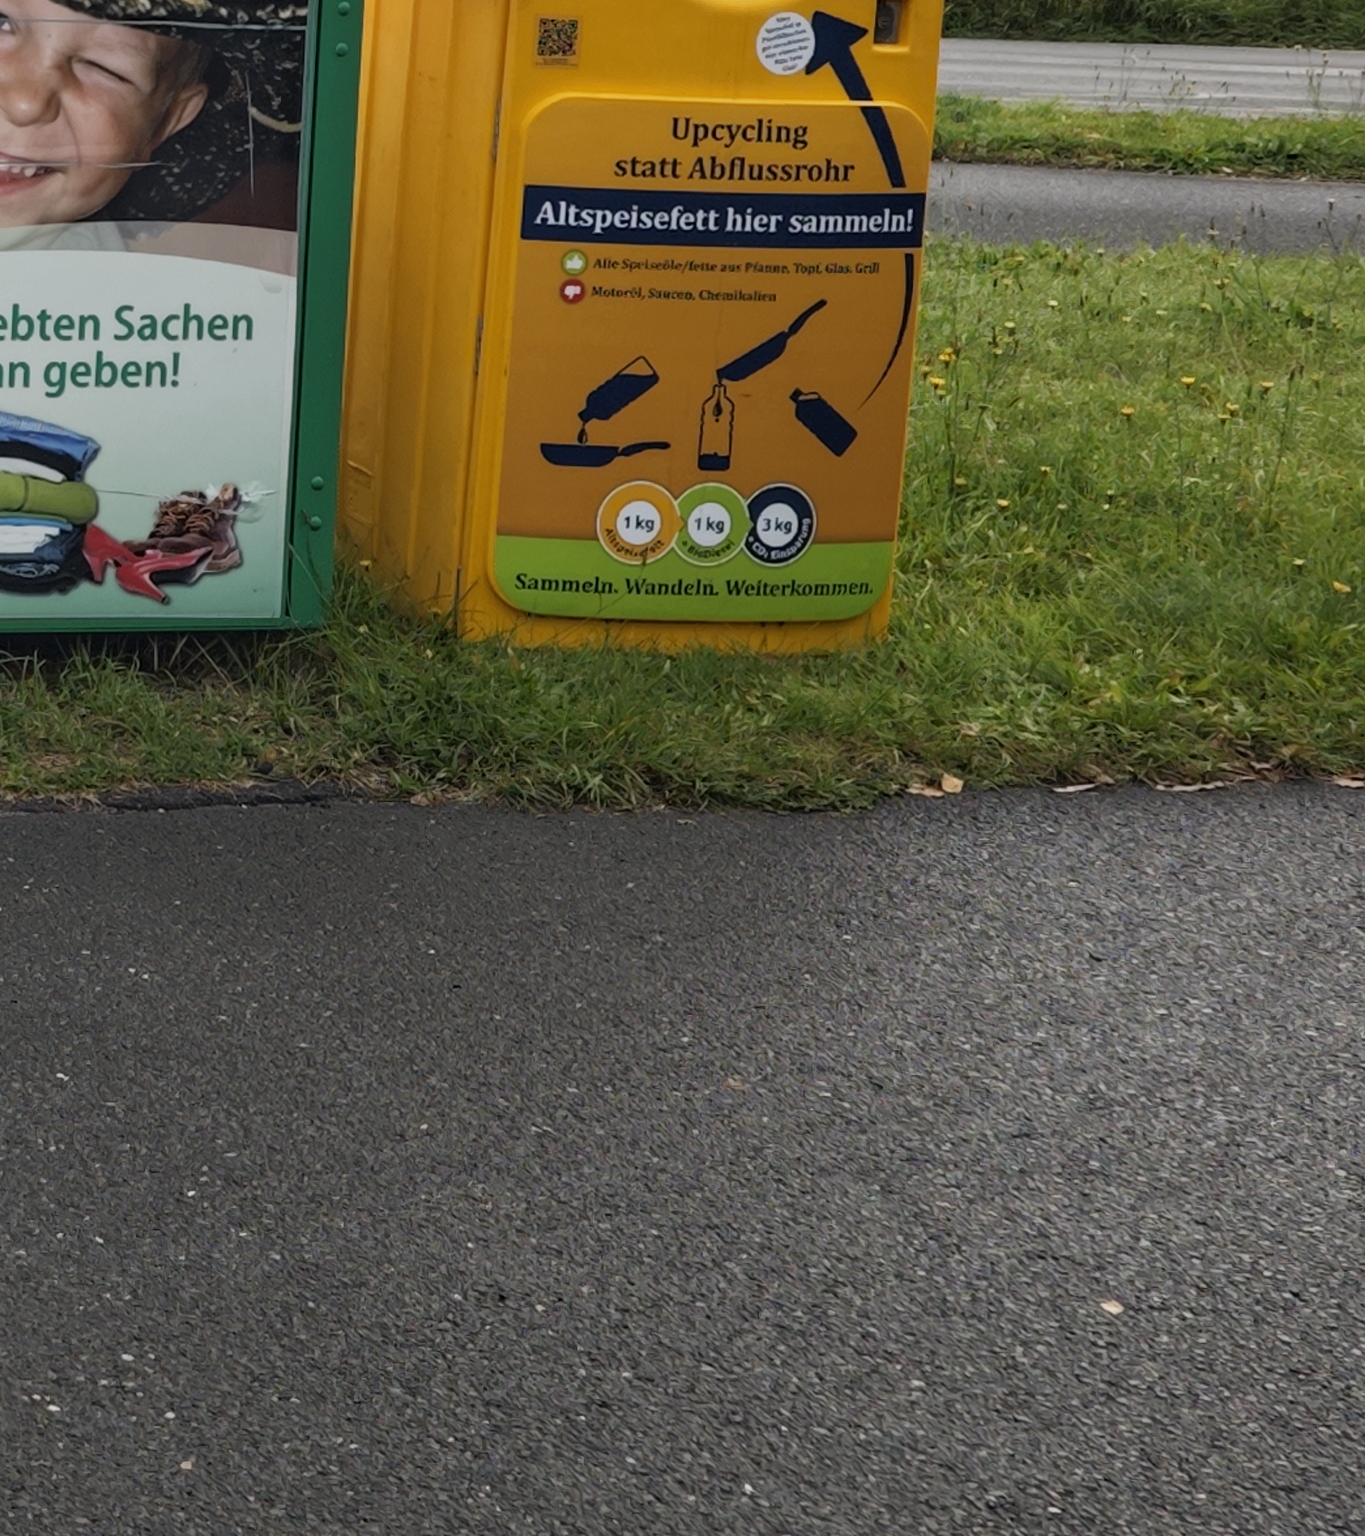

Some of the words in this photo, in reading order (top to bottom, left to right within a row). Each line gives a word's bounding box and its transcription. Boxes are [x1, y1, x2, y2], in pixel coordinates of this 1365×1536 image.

[672, 117, 809, 149] Upcycling
[614, 156, 681, 179] statt
[687, 156, 855, 182] Abflussrohr
[534, 200, 720, 234] Altspeisefett
[725, 207, 783, 232] hier
[788, 208, 914, 234] sammeln!
[593, 258, 619, 270] Alle
[591, 286, 646, 300] Motoröl,
[698, 289, 777, 302] Chemikalien
[113, 303, 254, 341] Sachen
[43, 351, 181, 398] geben!
[624, 516, 630, 529] 1
[635, 515, 655, 532] kg
[695, 518, 702, 531] 1
[706, 516, 725, 534] kg
[761, 518, 771, 532] 3
[774, 517, 793, 534] kg
[514, 572, 619, 595] Sammeln.
[624, 577, 719, 596] Wandeln.
[725, 578, 874, 597] Weiterkommen.
